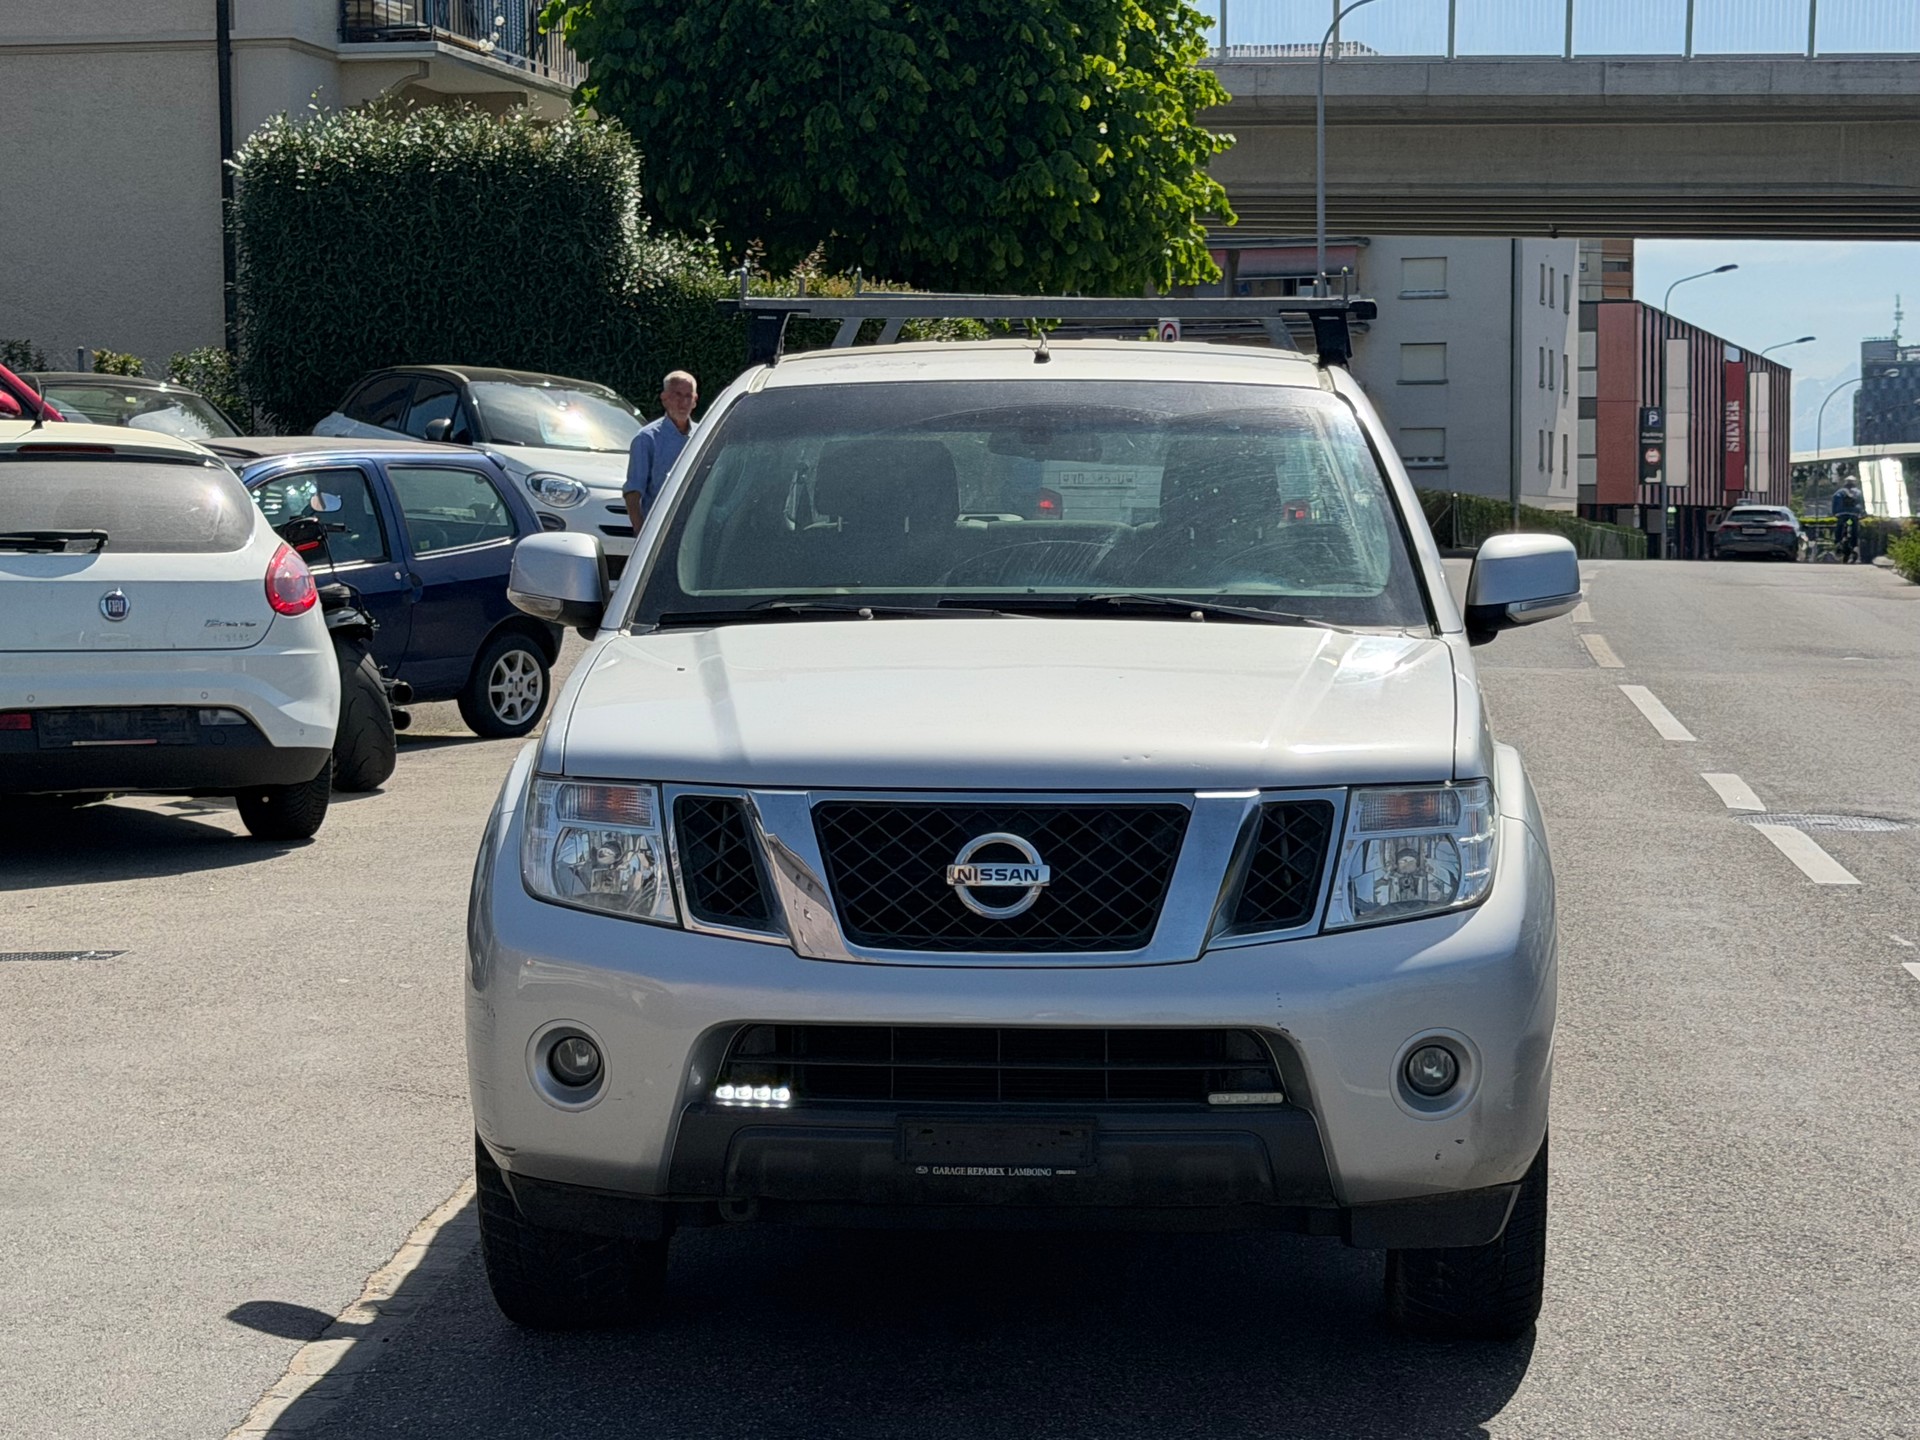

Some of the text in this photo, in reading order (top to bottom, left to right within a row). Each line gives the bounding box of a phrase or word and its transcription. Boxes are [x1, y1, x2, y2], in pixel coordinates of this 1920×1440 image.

[1648, 413, 1659, 426] P
[1725, 400, 1740, 452] SILVER
[957, 868, 1040, 882] NISSAN
[932, 1166, 966, 1175] GARAGE
[967, 1166, 1005, 1176] REPAREX
[1008, 1167, 1052, 1177] LAMBOING
